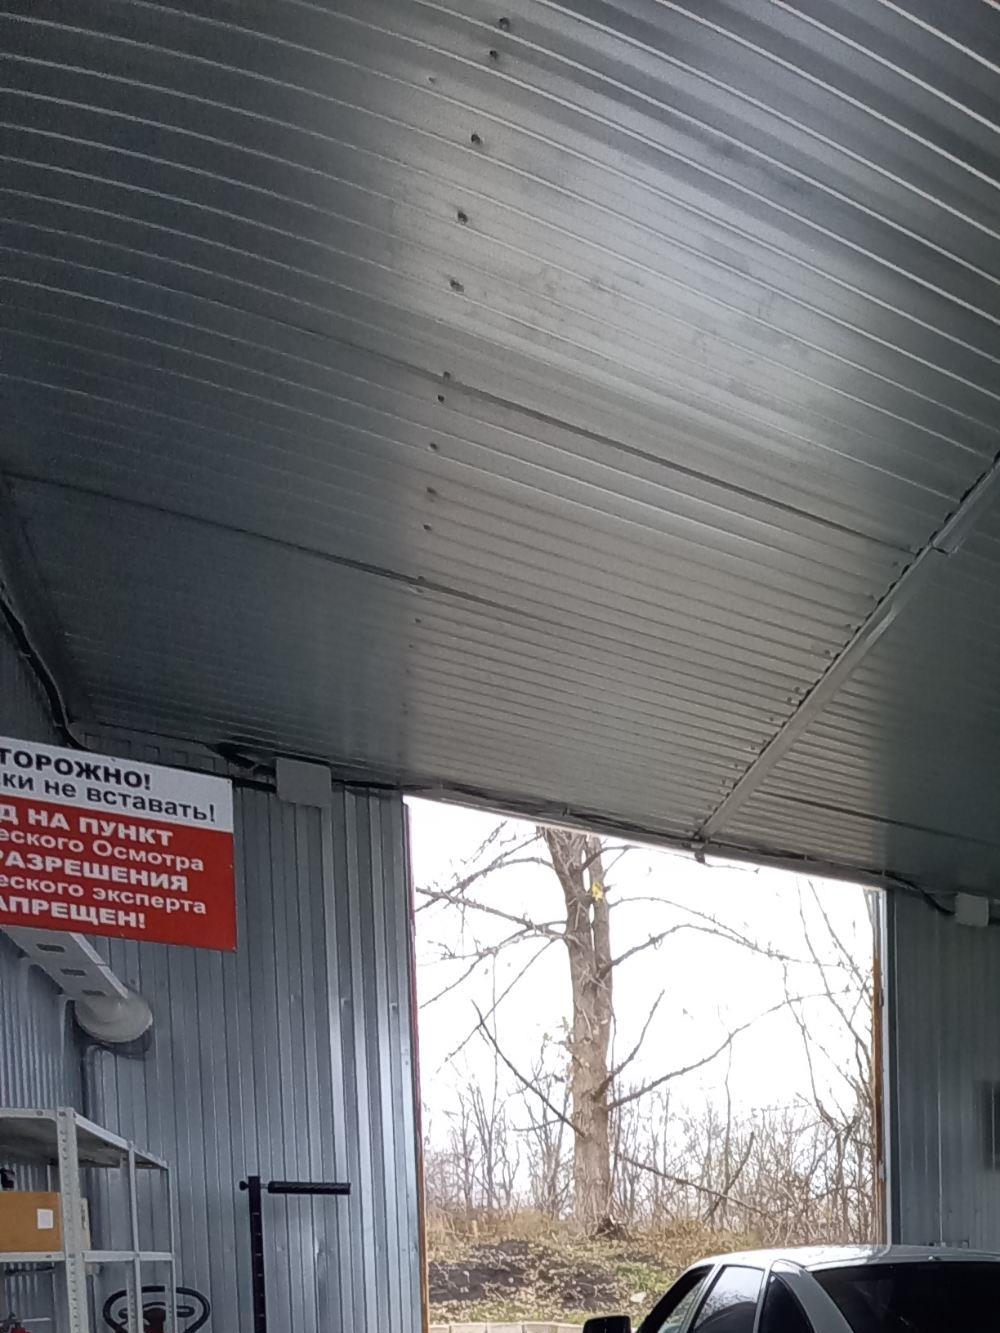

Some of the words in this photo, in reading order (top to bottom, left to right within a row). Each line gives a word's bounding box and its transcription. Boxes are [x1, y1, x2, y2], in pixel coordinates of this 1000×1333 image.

[44, 780, 77, 798] не
[86, 787, 215, 823] вставать!
[28, 809, 70, 831] НА
[79, 817, 173, 847] ПУНКТ
[0, 829, 84, 853] еского
[92, 840, 204, 872] Осмотра
[0, 851, 188, 892] АЗРЕШЕНИЯ
[0, 875, 84, 898] еского
[92, 888, 207, 915] эксперта
